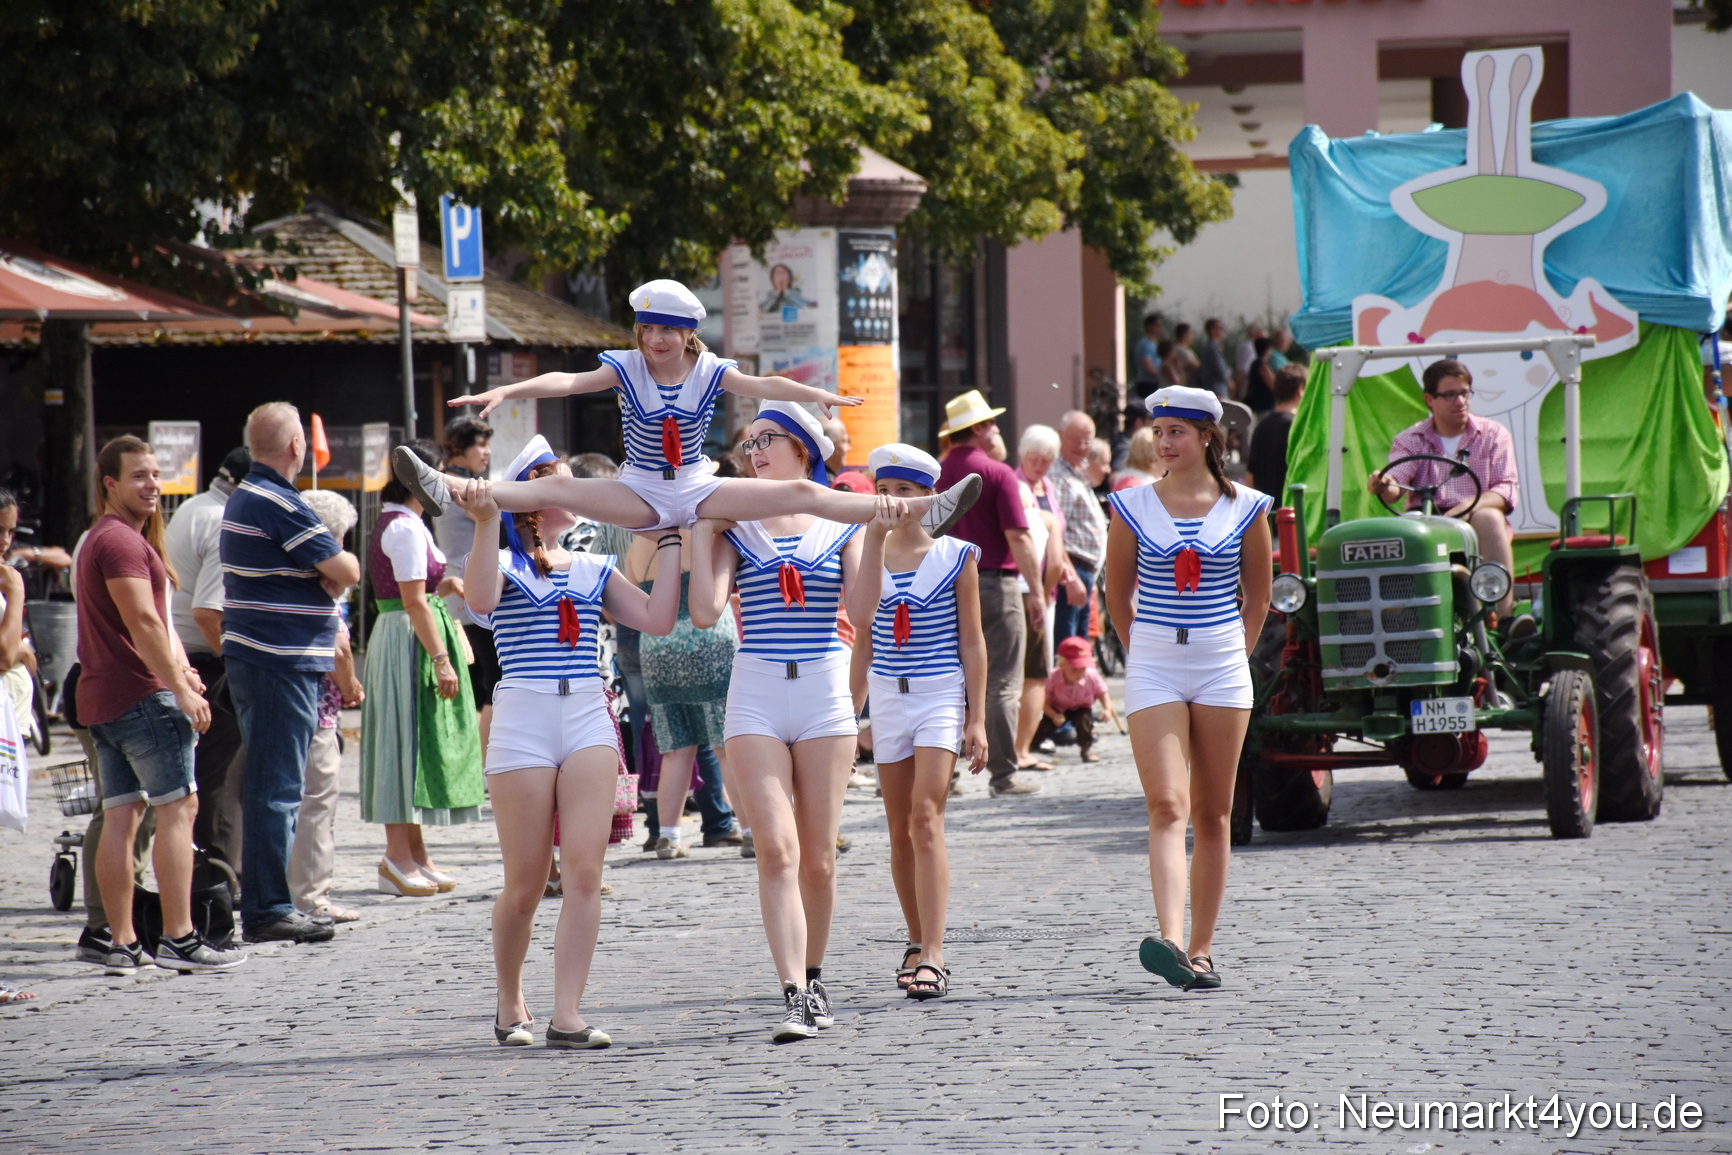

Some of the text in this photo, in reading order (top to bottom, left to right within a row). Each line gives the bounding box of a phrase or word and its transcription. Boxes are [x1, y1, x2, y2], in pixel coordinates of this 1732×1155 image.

[450, 202, 473, 268] P
[1344, 541, 1401, 562] FAHR
[1426, 702, 1446, 716] NM
[1416, 716, 1467, 732] H1955
